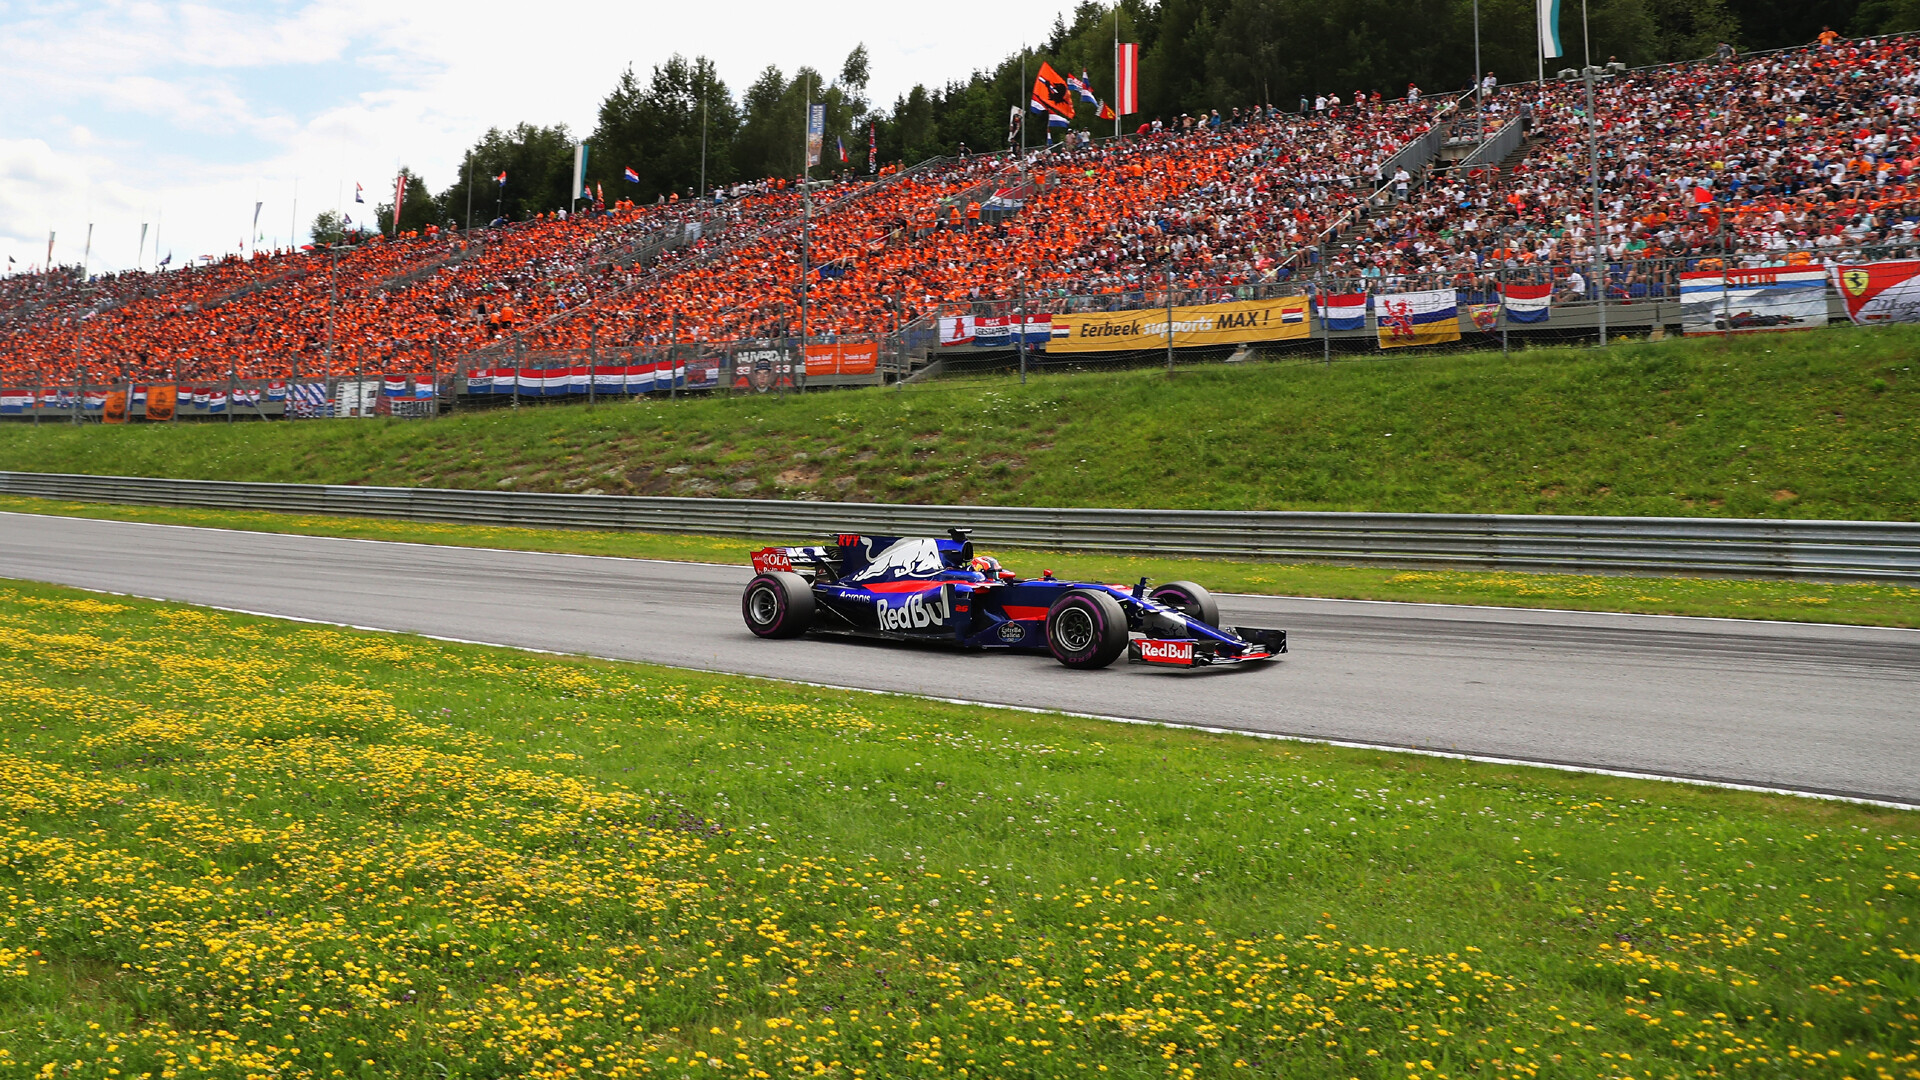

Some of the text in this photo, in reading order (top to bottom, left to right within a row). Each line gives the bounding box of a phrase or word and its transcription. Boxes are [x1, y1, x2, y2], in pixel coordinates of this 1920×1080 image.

[1080, 320, 1141, 337] Eerbeek
[1142, 316, 1213, 338] supports
[1216, 312, 1259, 329] MAX
[736, 366, 751, 375] 33
[838, 534, 860, 547] KVY
[762, 553, 789, 566] COLA
[840, 590, 871, 604] Acronis
